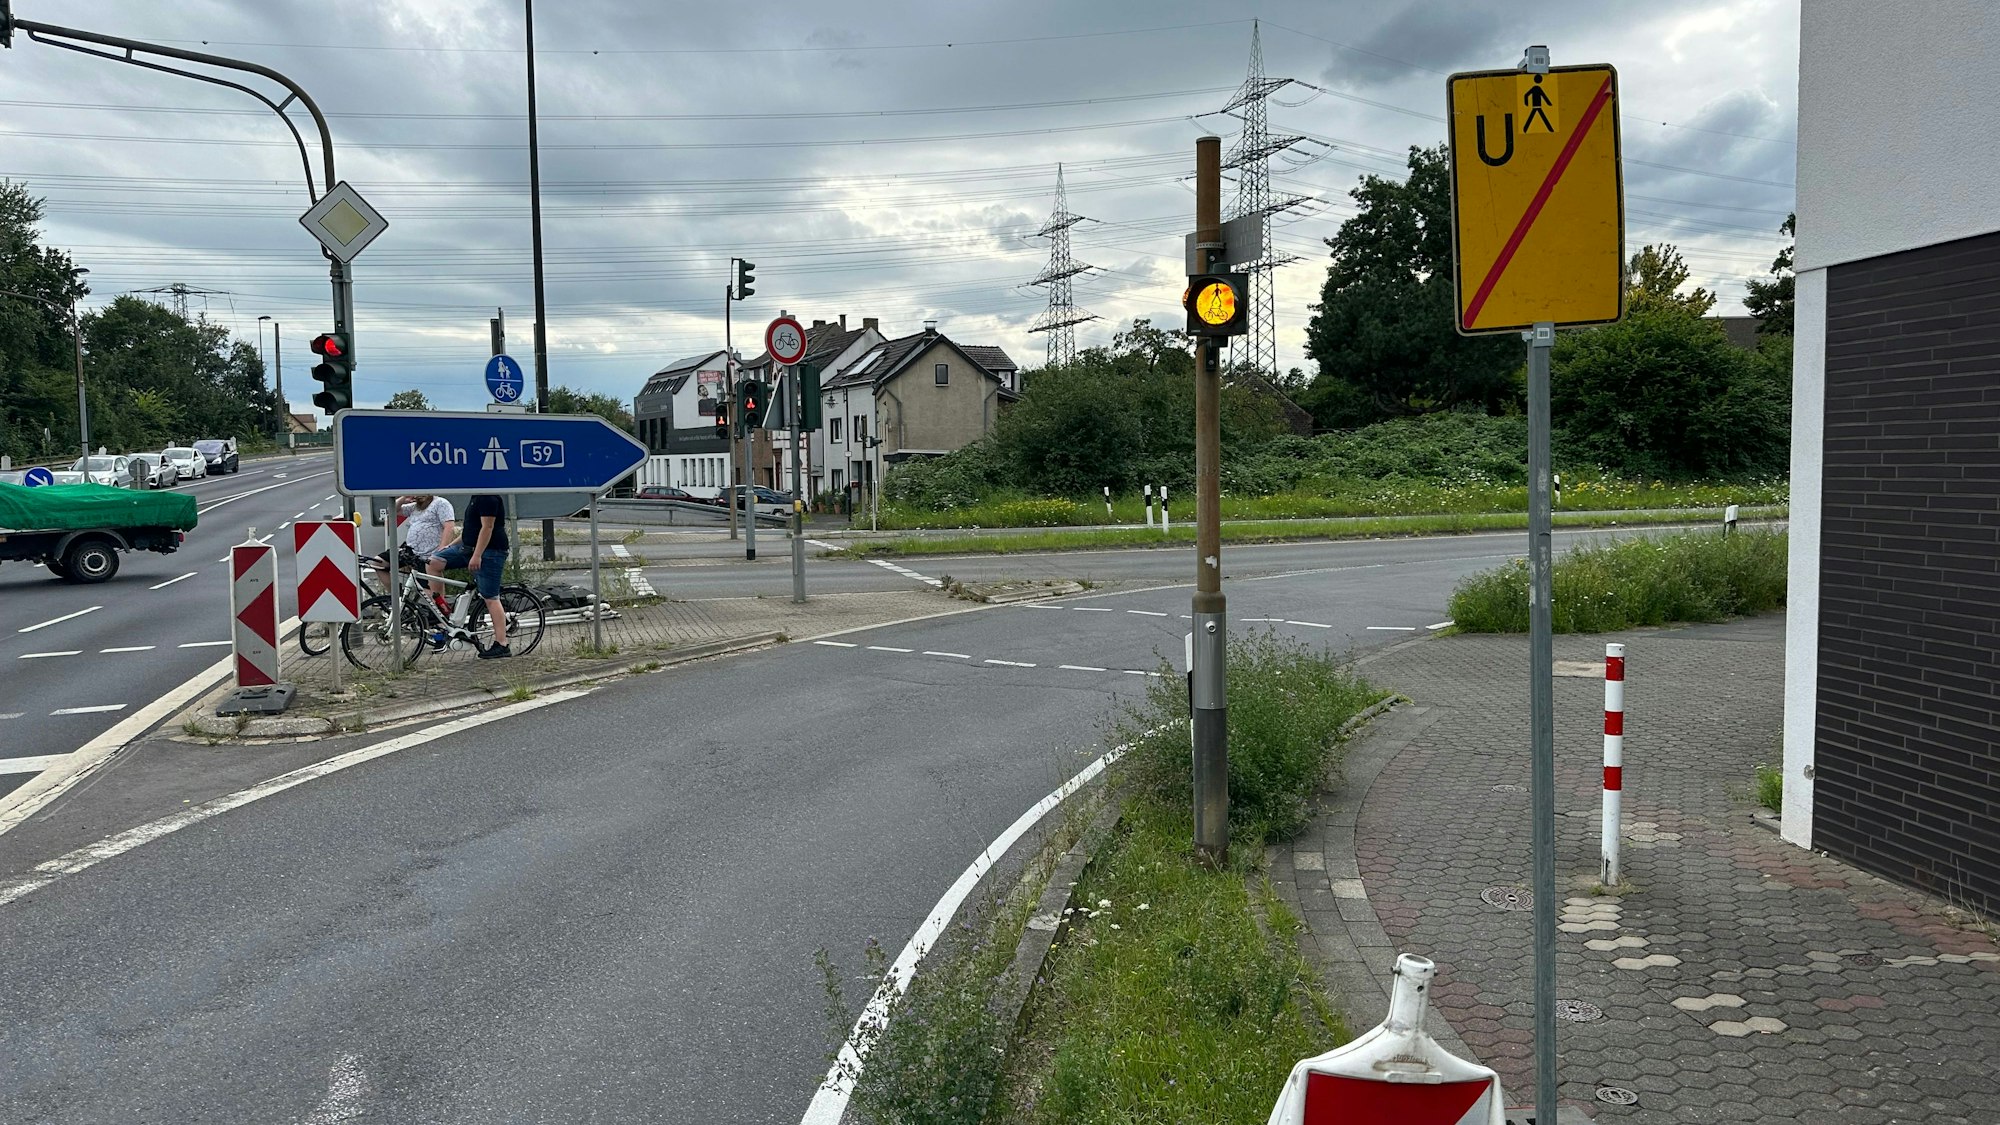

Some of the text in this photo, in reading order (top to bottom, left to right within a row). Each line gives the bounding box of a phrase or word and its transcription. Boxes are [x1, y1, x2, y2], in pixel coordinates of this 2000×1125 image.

[1476, 114, 1513, 166] U
[410, 442, 467, 465] Köln
[532, 446, 553, 462] 59
